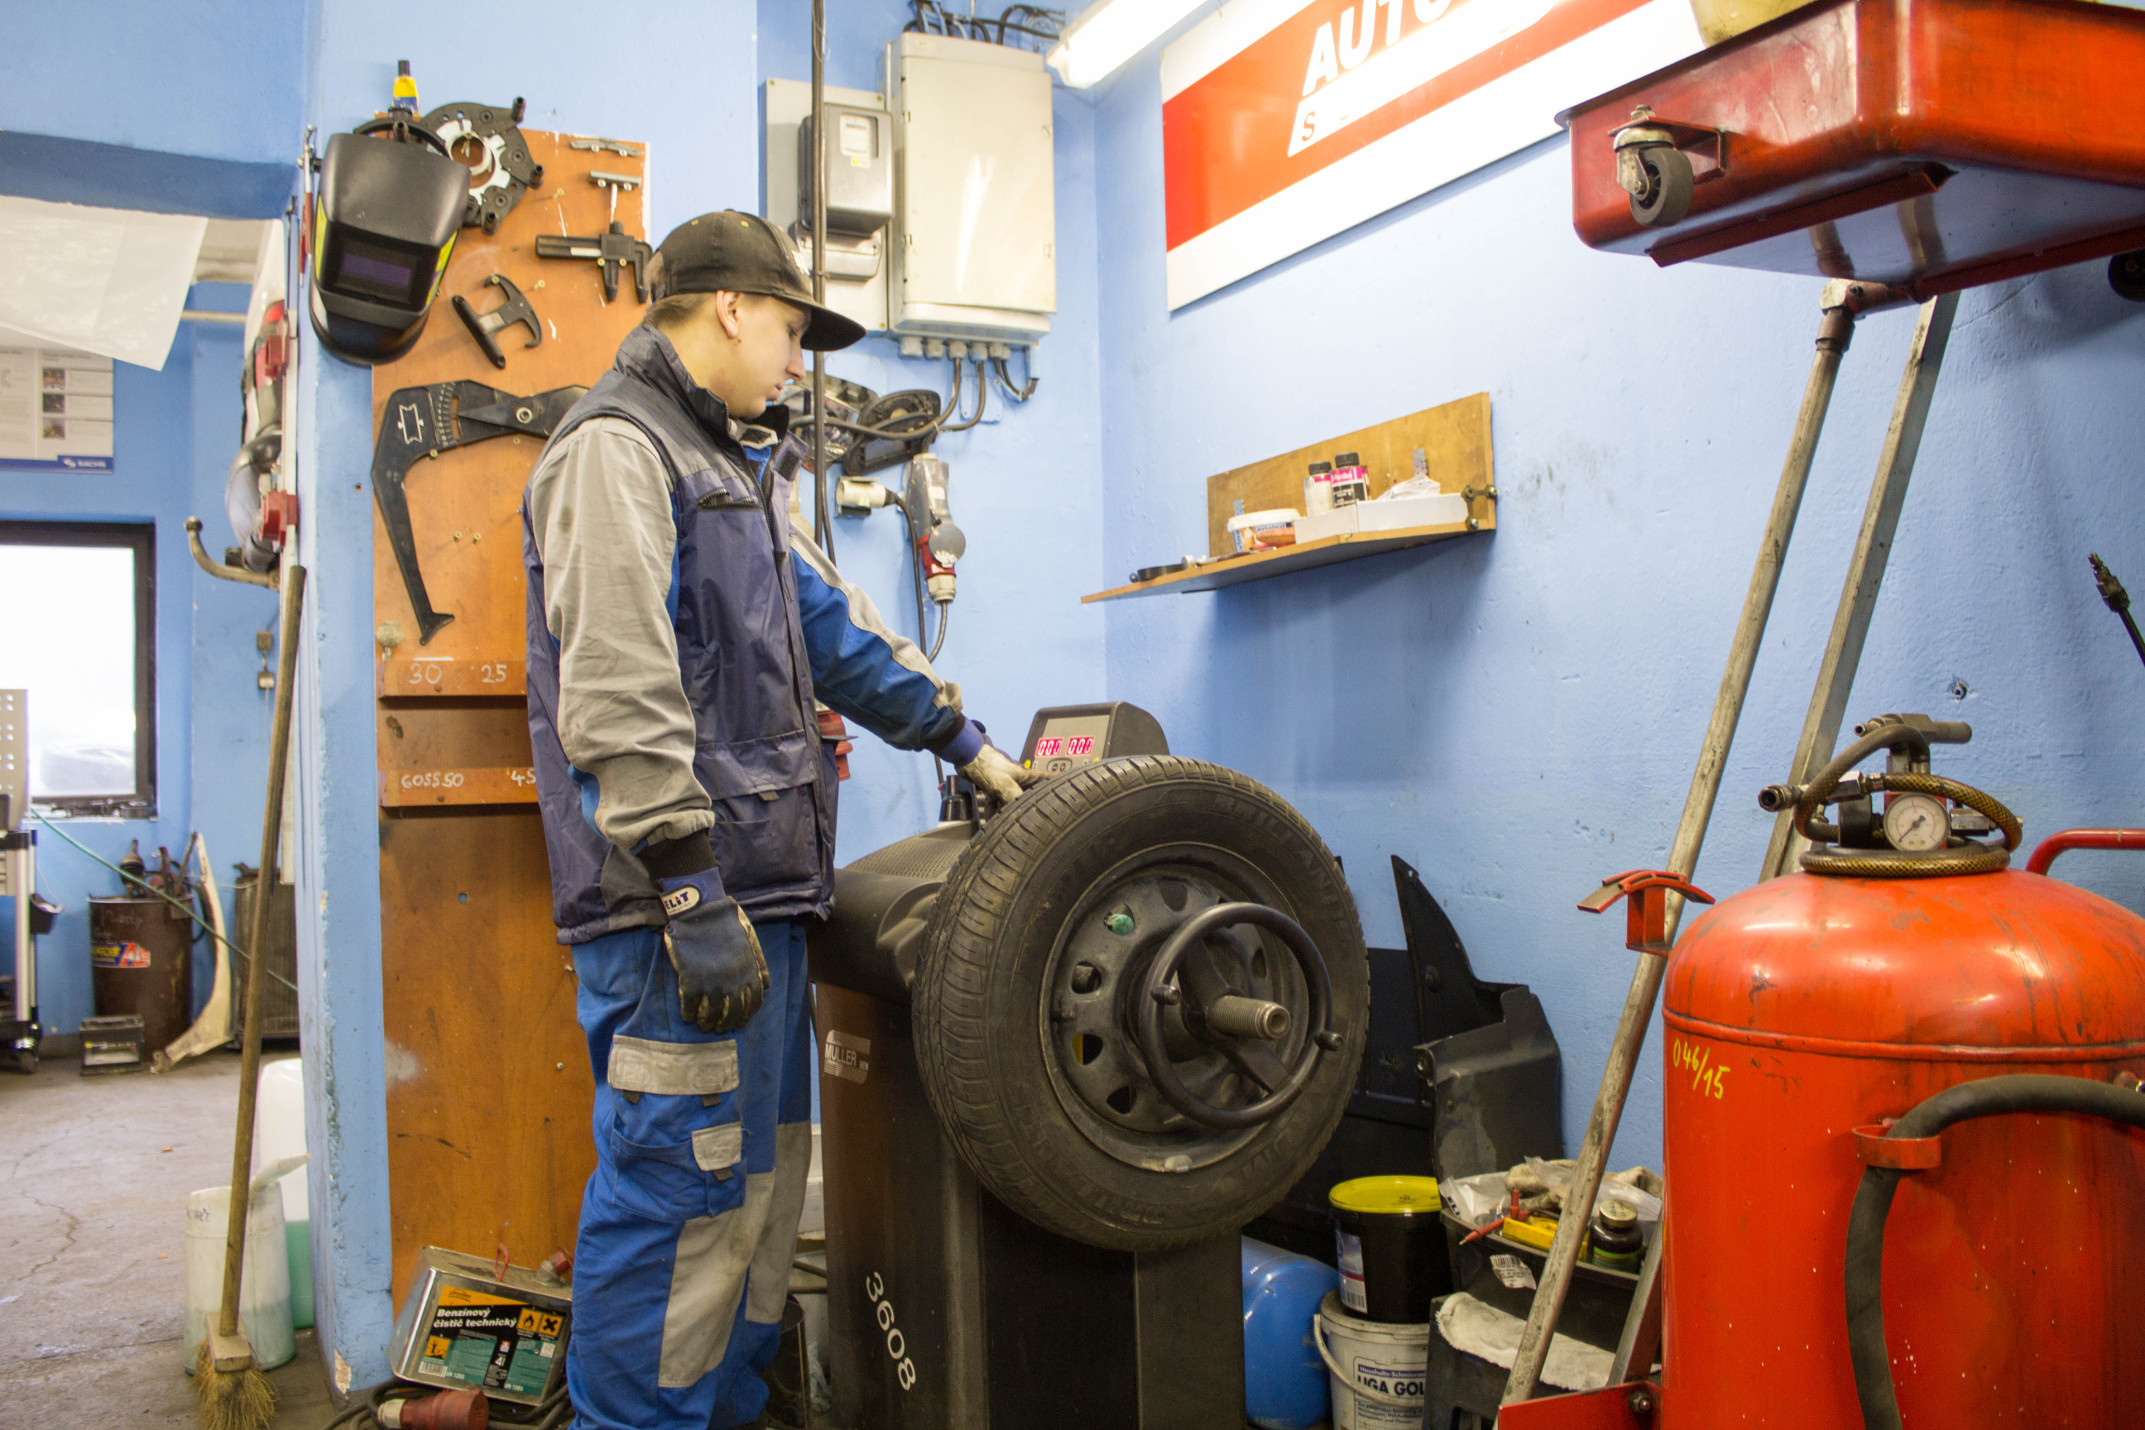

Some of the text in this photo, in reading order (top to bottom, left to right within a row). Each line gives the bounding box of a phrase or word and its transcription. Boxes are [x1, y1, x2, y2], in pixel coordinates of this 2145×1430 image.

[409, 662, 507, 684] 30 25
[433, 1318, 518, 1328] čistič technický
[866, 1271, 916, 1391] 3608
